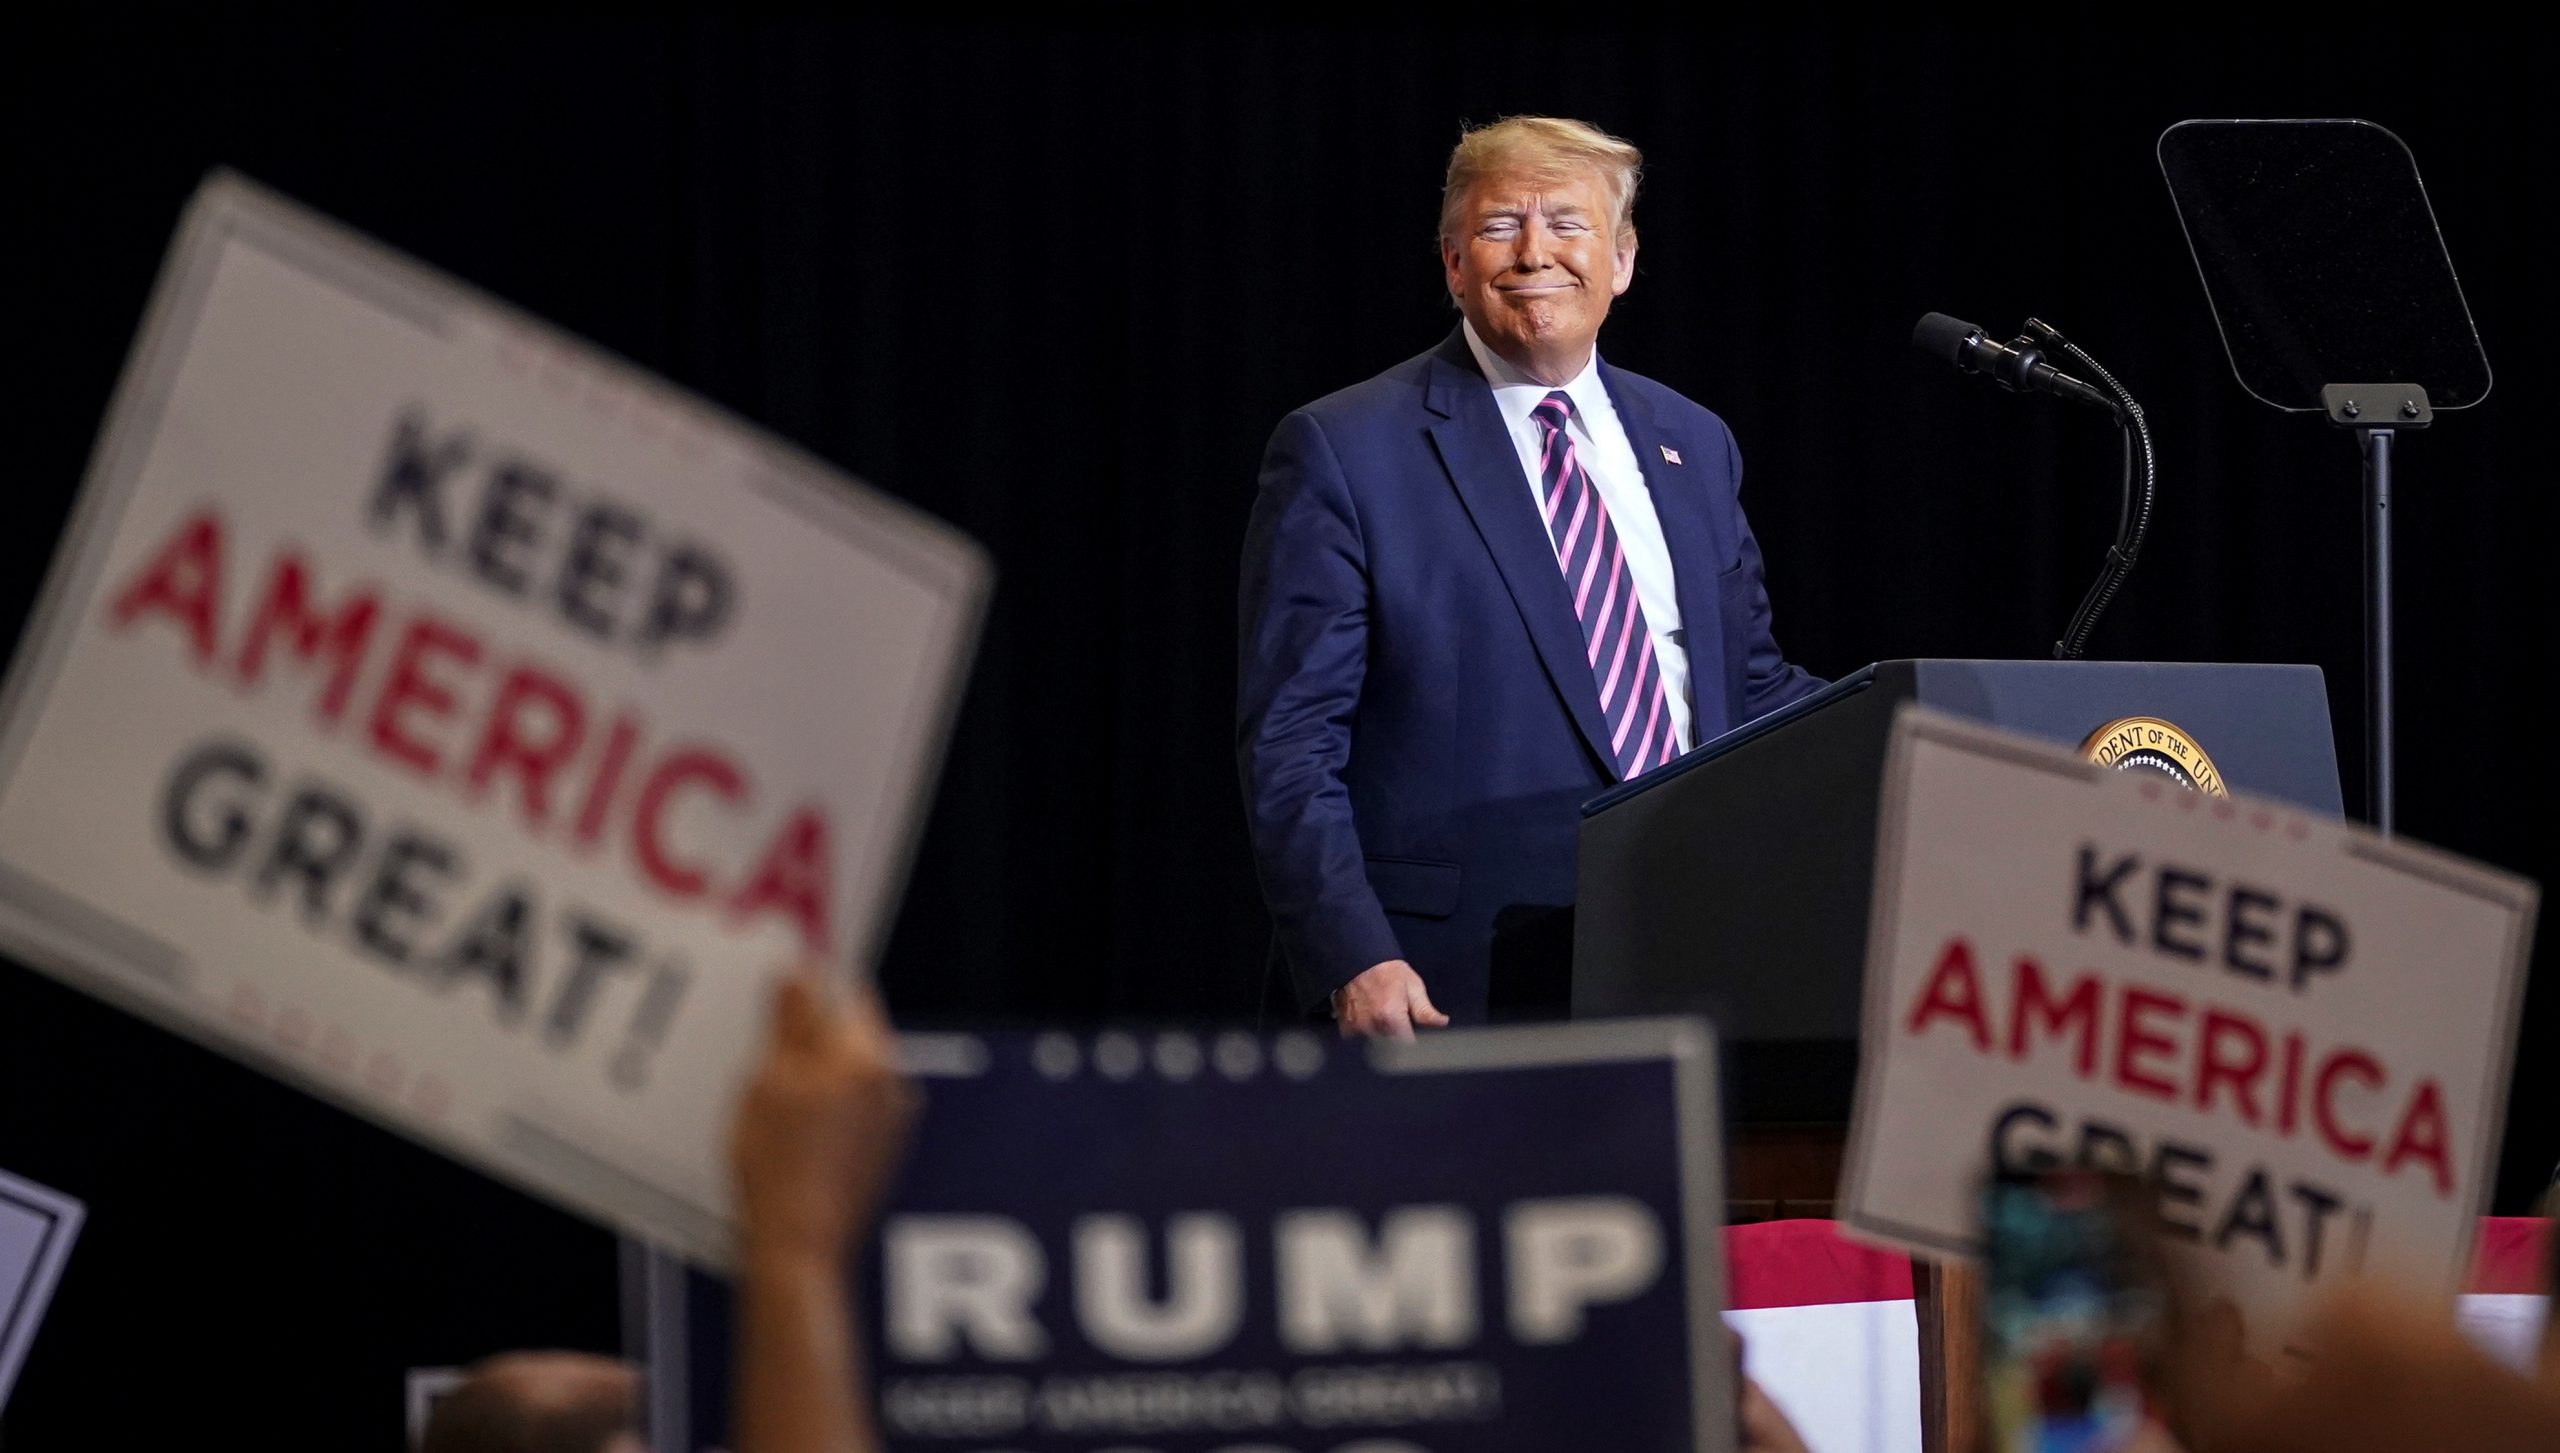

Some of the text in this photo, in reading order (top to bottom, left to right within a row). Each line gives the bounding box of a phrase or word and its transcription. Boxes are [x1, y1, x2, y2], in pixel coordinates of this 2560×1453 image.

[368, 410, 736, 664] KEEP
[110, 504, 838, 952] AMERICA
[2148, 729, 2164, 744] OF
[2167, 735, 2187, 760] THE
[2193, 759, 2219, 794] UN
[158, 738, 692, 1092] GREAT!
[2071, 846, 2349, 991] KEEP
[1908, 936, 2454, 1196] AMERICA
[884, 1194, 1662, 1361] RUMP
